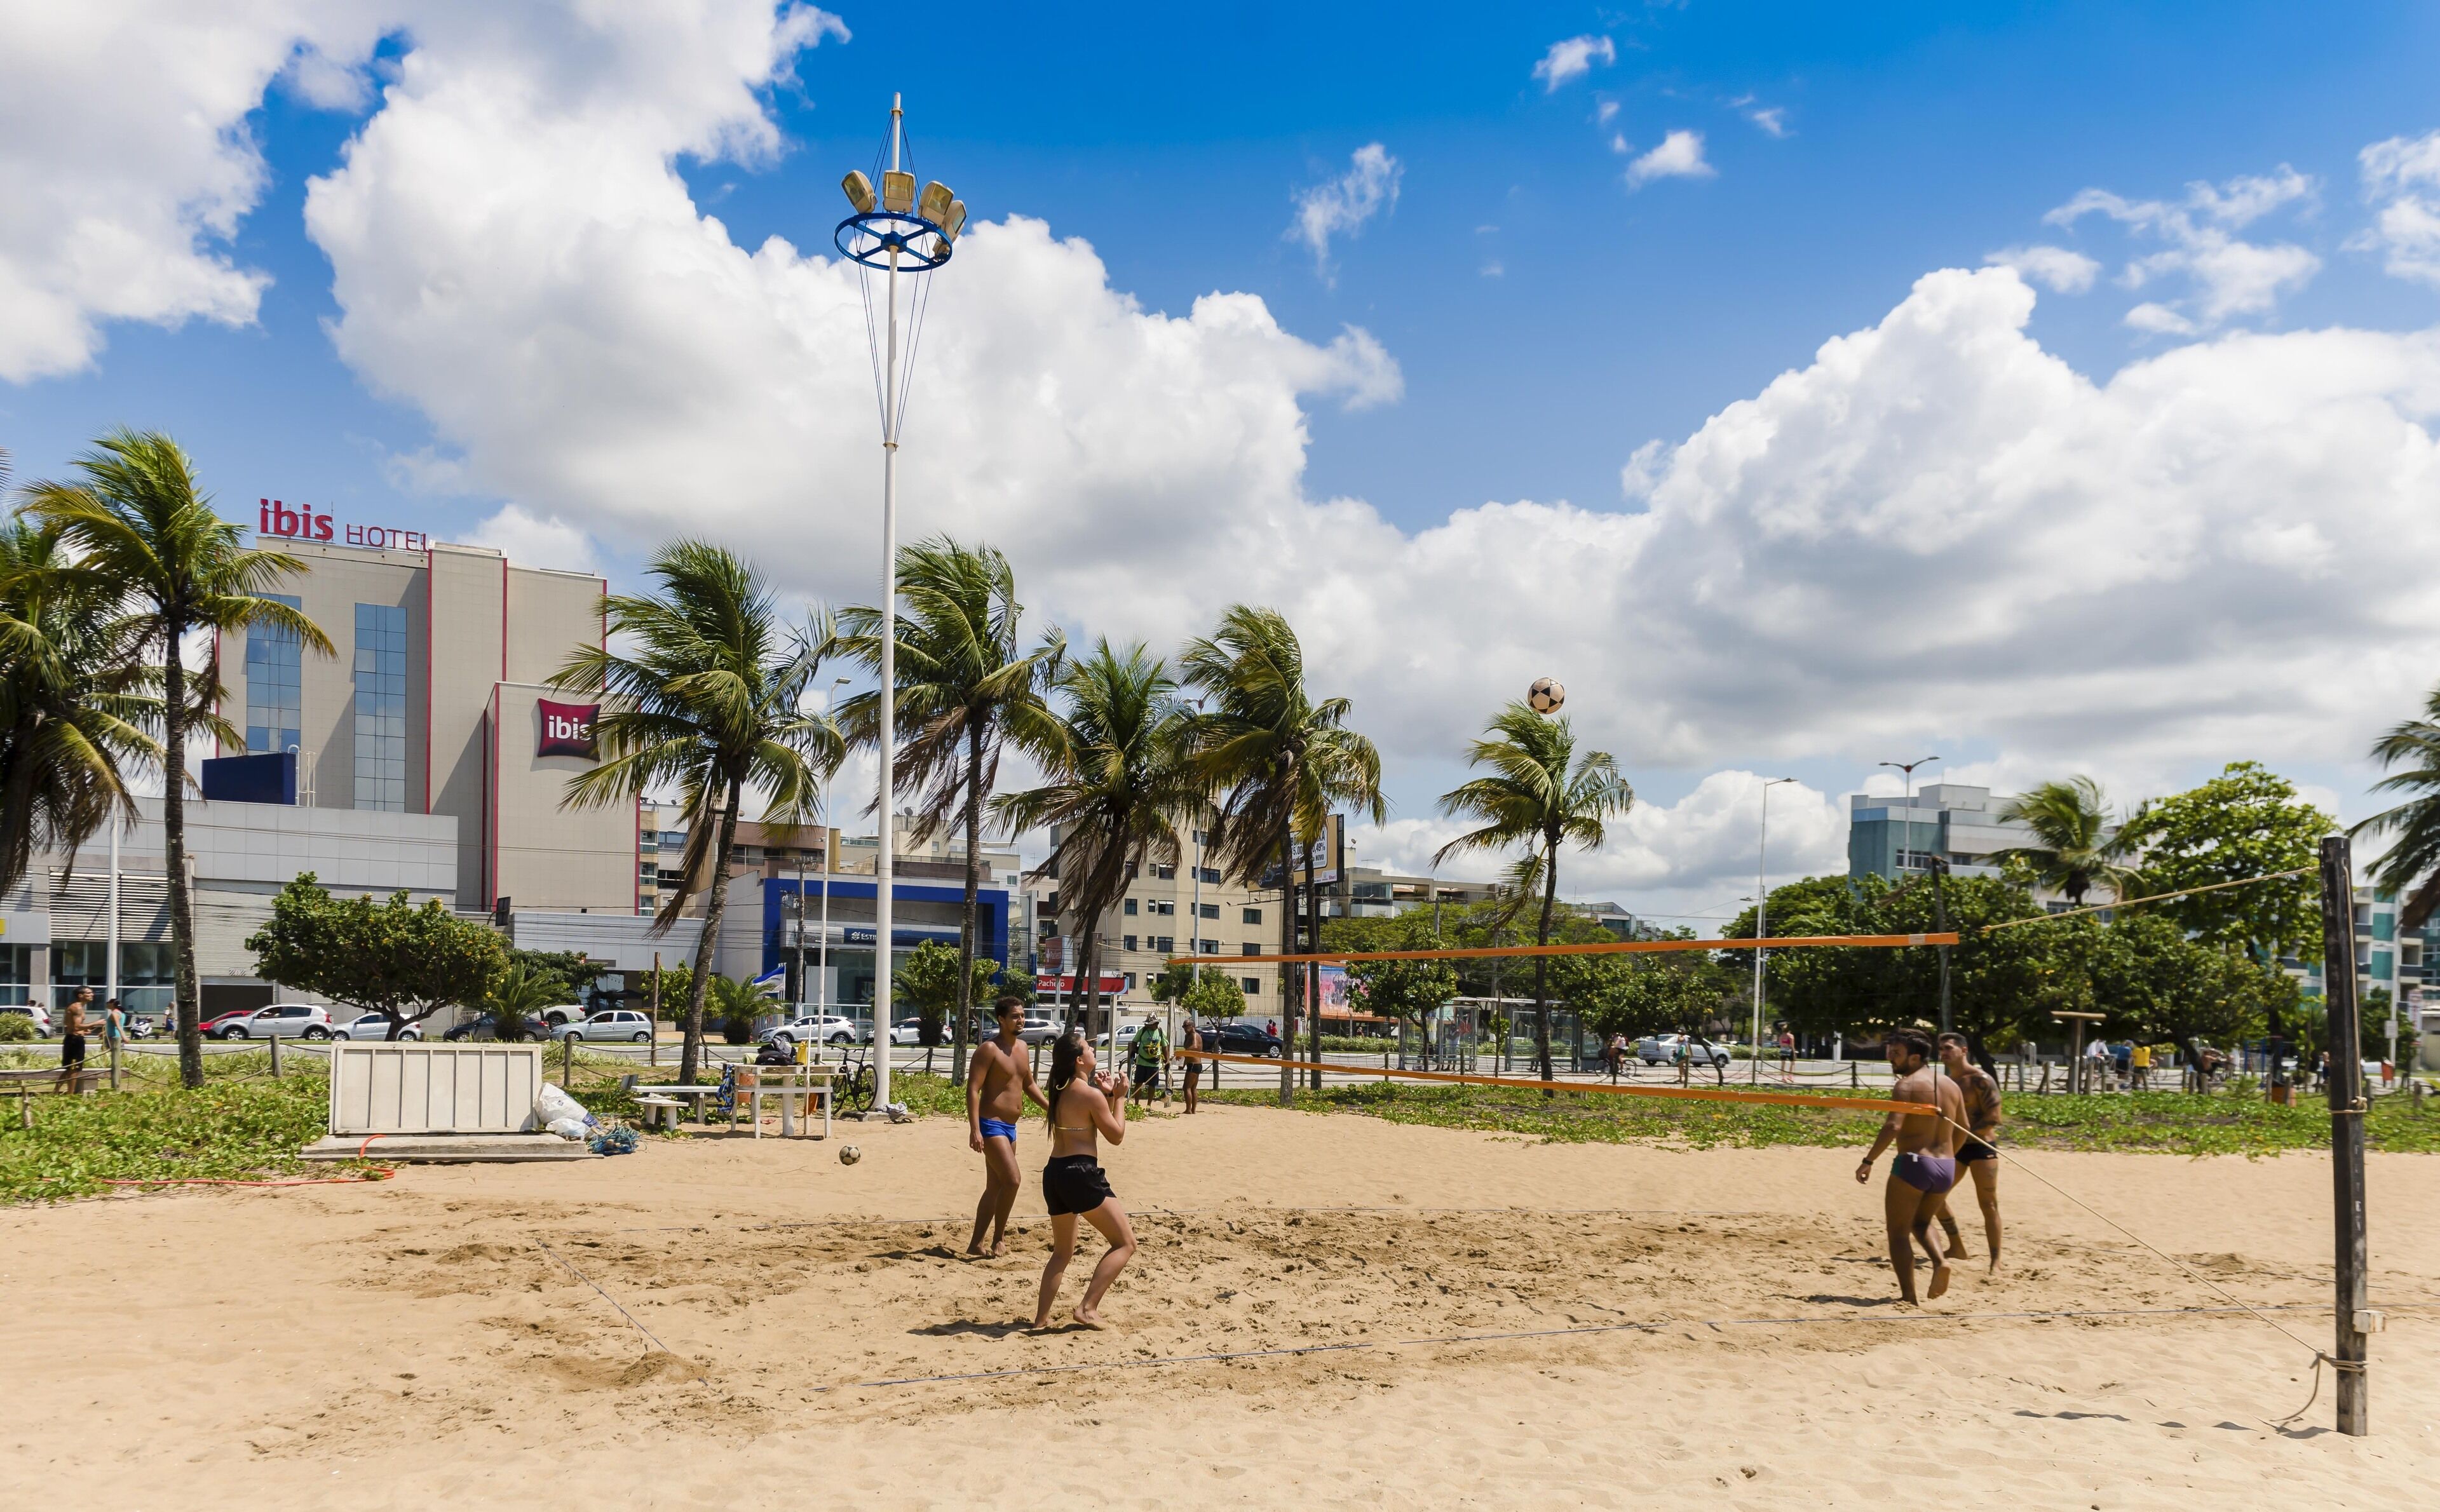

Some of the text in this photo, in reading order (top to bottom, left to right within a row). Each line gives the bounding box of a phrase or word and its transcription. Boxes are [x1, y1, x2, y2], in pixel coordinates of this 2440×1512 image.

[260, 498, 429, 553] ibis HOTEL
[548, 715, 592, 741] ibis
